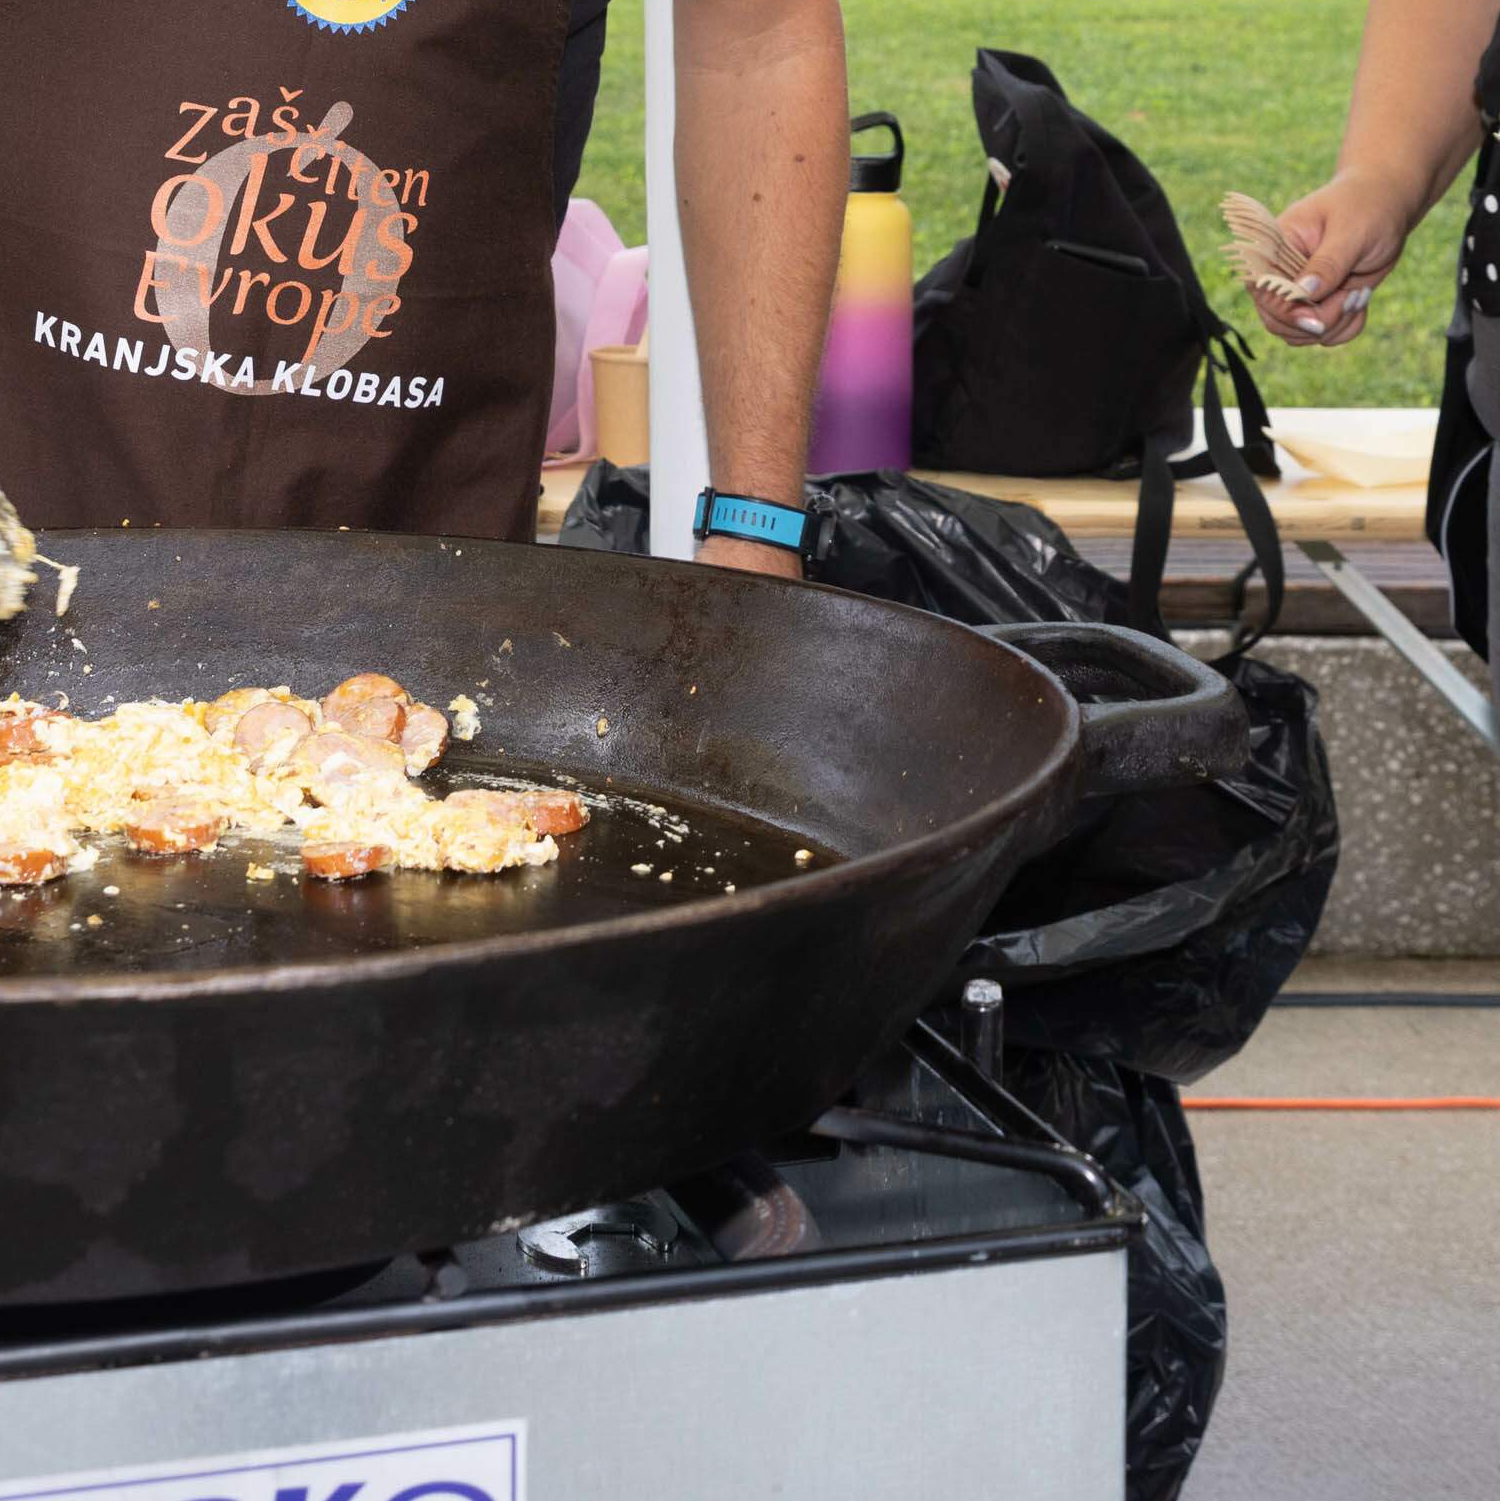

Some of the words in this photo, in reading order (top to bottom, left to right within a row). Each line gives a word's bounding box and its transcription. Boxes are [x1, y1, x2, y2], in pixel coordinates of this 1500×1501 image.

[150, 152, 419, 282] okus
[33, 310, 256, 390] KRANJSKA
[270, 357, 446, 409] KLOBASA
[133, 250, 402, 362] Evrope
